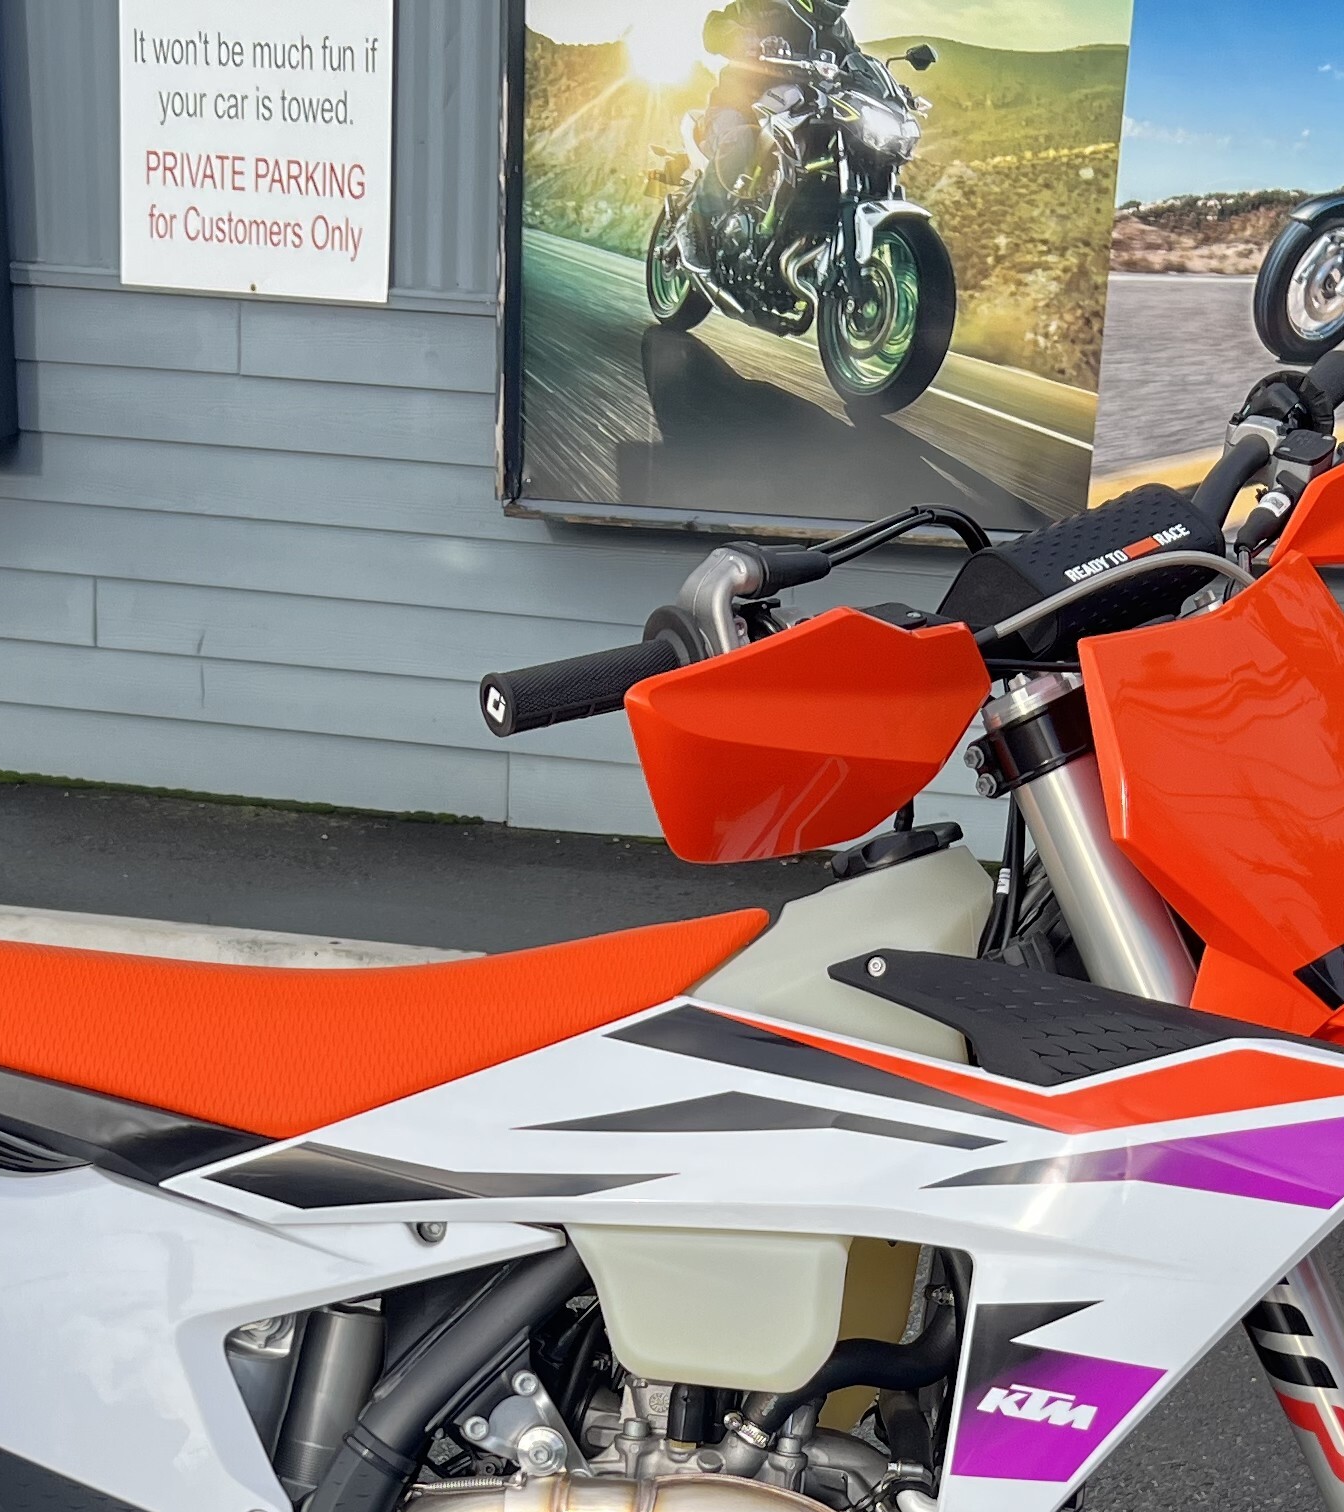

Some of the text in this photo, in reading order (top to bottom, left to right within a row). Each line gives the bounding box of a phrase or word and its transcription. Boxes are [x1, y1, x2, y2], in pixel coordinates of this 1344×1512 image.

[133, 28, 378, 73] It won't be much fun if
[158, 87, 354, 125] your car is towed.
[145, 150, 366, 200] PRIVATE PARKING
[148, 204, 363, 262] for Customers Only
[1064, 522, 1191, 583] READY TO RACE
[976, 1383, 1098, 1431] KTM
